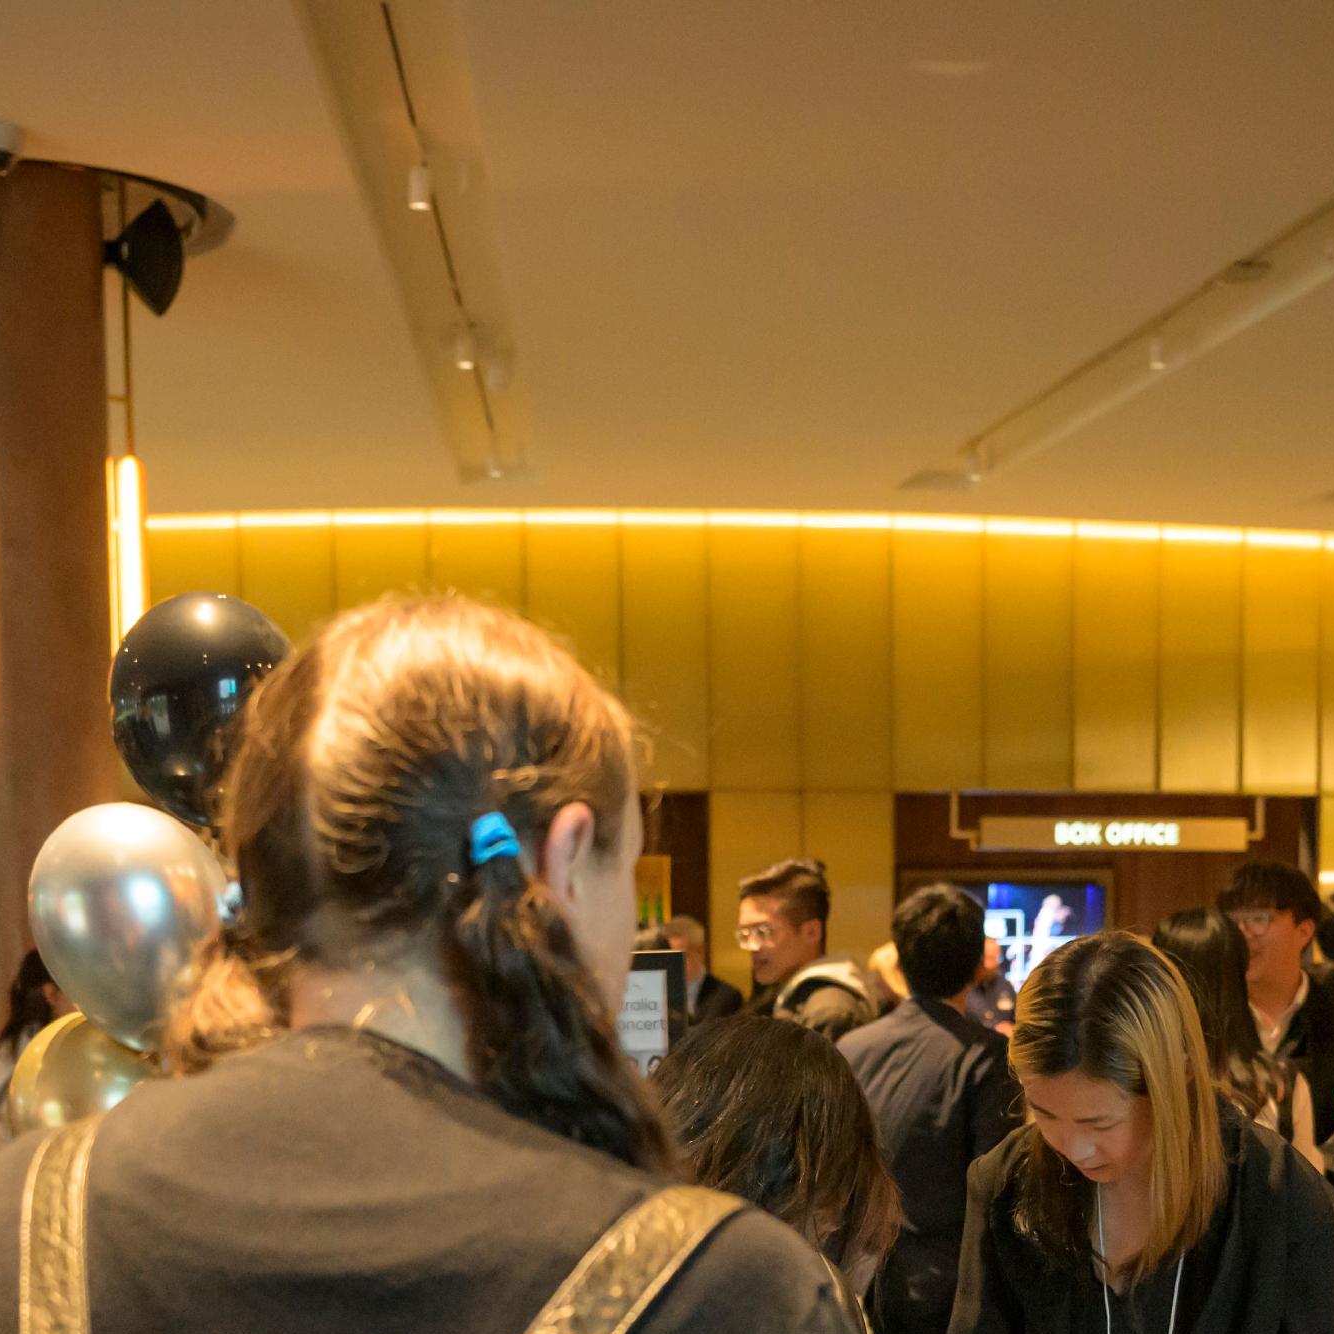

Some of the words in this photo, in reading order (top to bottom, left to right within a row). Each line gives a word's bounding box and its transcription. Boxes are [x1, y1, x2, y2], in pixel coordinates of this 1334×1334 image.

[1054, 821, 1102, 846] BOX
[1105, 821, 1180, 846] OFFICE
[625, 996, 659, 1012] ralia
[618, 1016, 666, 1031] oncert
